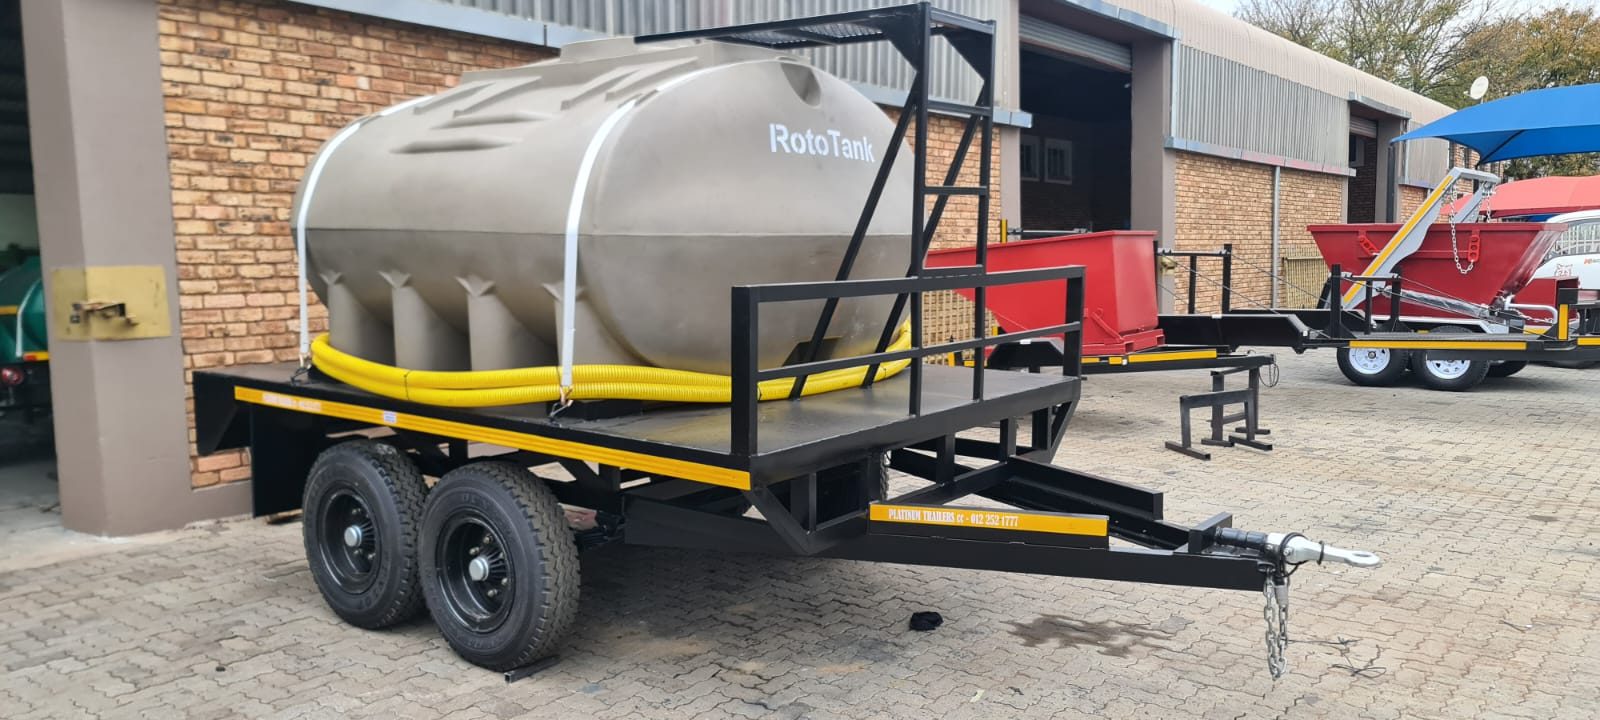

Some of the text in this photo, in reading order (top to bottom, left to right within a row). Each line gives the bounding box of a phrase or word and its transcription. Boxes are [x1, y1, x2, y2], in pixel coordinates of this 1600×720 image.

[769, 123, 875, 163] RotoTank
[888, 509, 921, 521] PLATINUM
[923, 510, 955, 523] TRAILERS
[971, 513, 984, 525] 012
[985, 514, 1000, 526] 252
[1001, 515, 1019, 527] 1777
